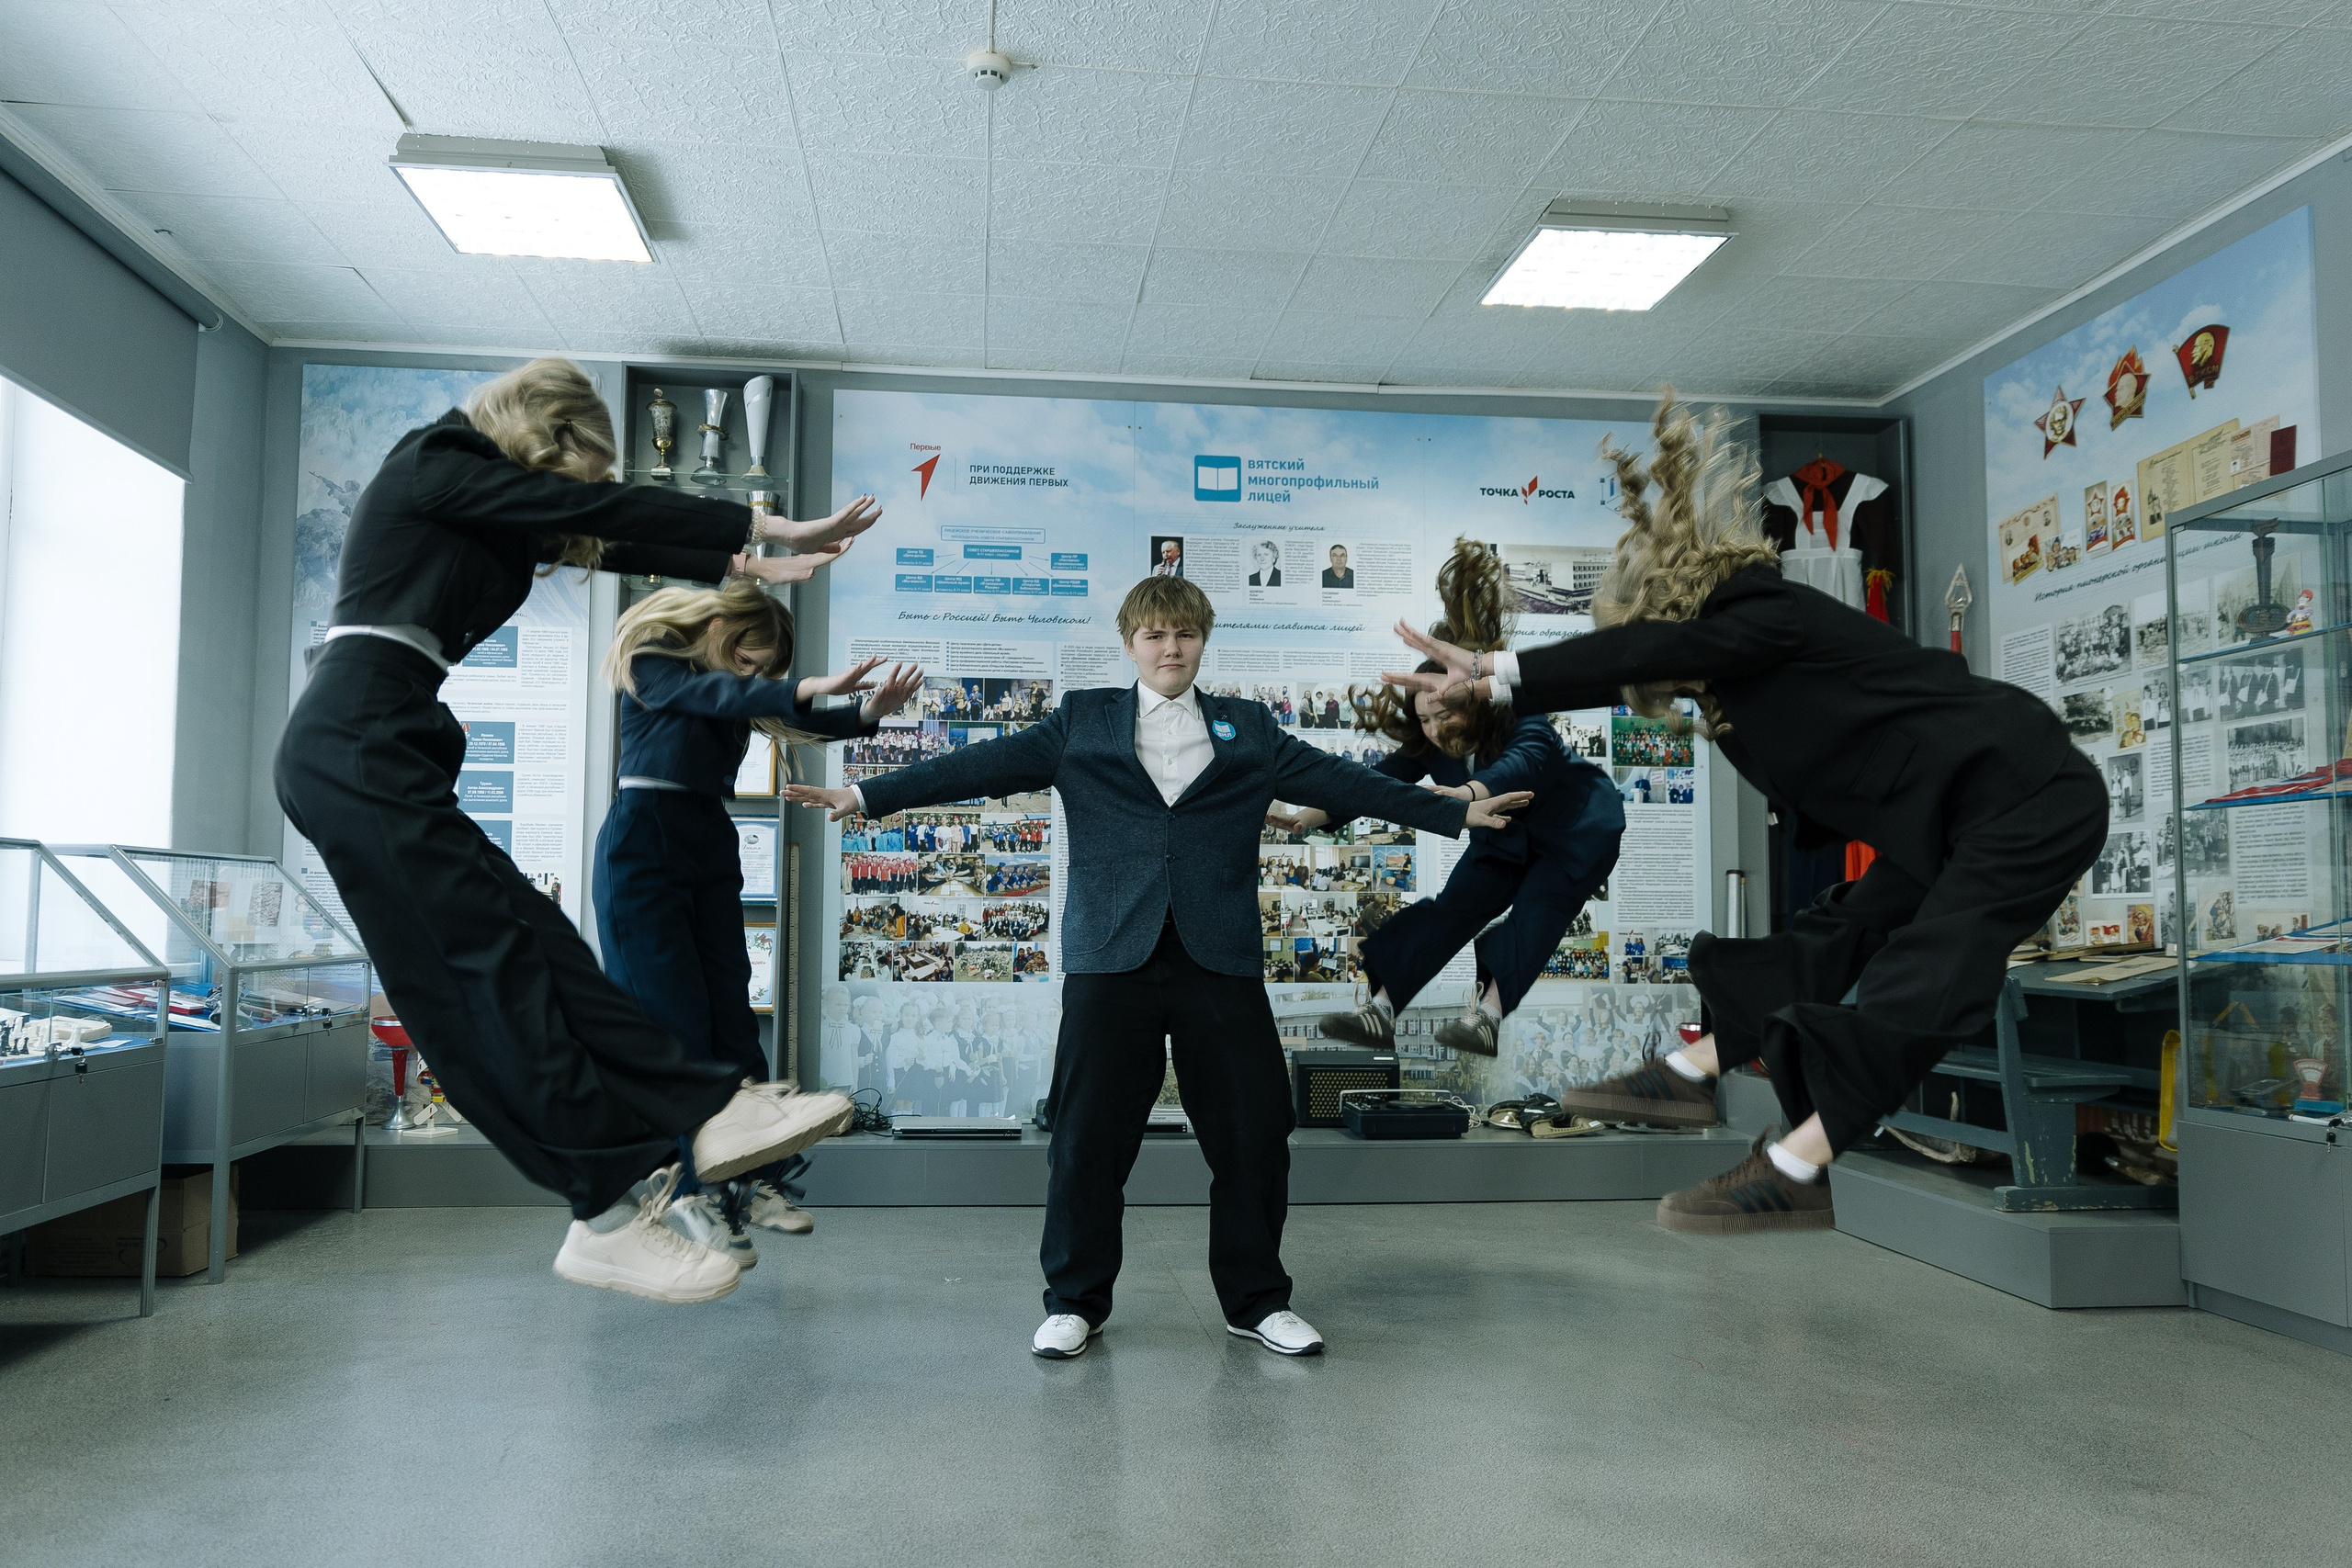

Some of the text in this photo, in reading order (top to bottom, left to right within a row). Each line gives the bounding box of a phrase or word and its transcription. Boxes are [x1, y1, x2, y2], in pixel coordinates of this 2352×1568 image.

[910, 443, 942, 452] Первые
[969, 465, 1056, 476] ПРИ ПОДДЕРЖКЕ
[969, 476, 1069, 487] ДВИЖЕНИЯ ПЕРВЫХ
[1248, 475, 1379, 490] многопрофильный
[1247, 490, 1291, 503] лицей
[1480, 488, 1575, 499] ТОЧКА РОСТА
[1233, 522, 1326, 533] Заслуженные учителя
[899, 611, 932, 621] Быть
[942, 612, 990, 622] Россией!
[992, 614, 1025, 623] Быть
[1028, 615, 1091, 625] Человеком!
[1214, 622, 1366, 634] ителями славится лицей
